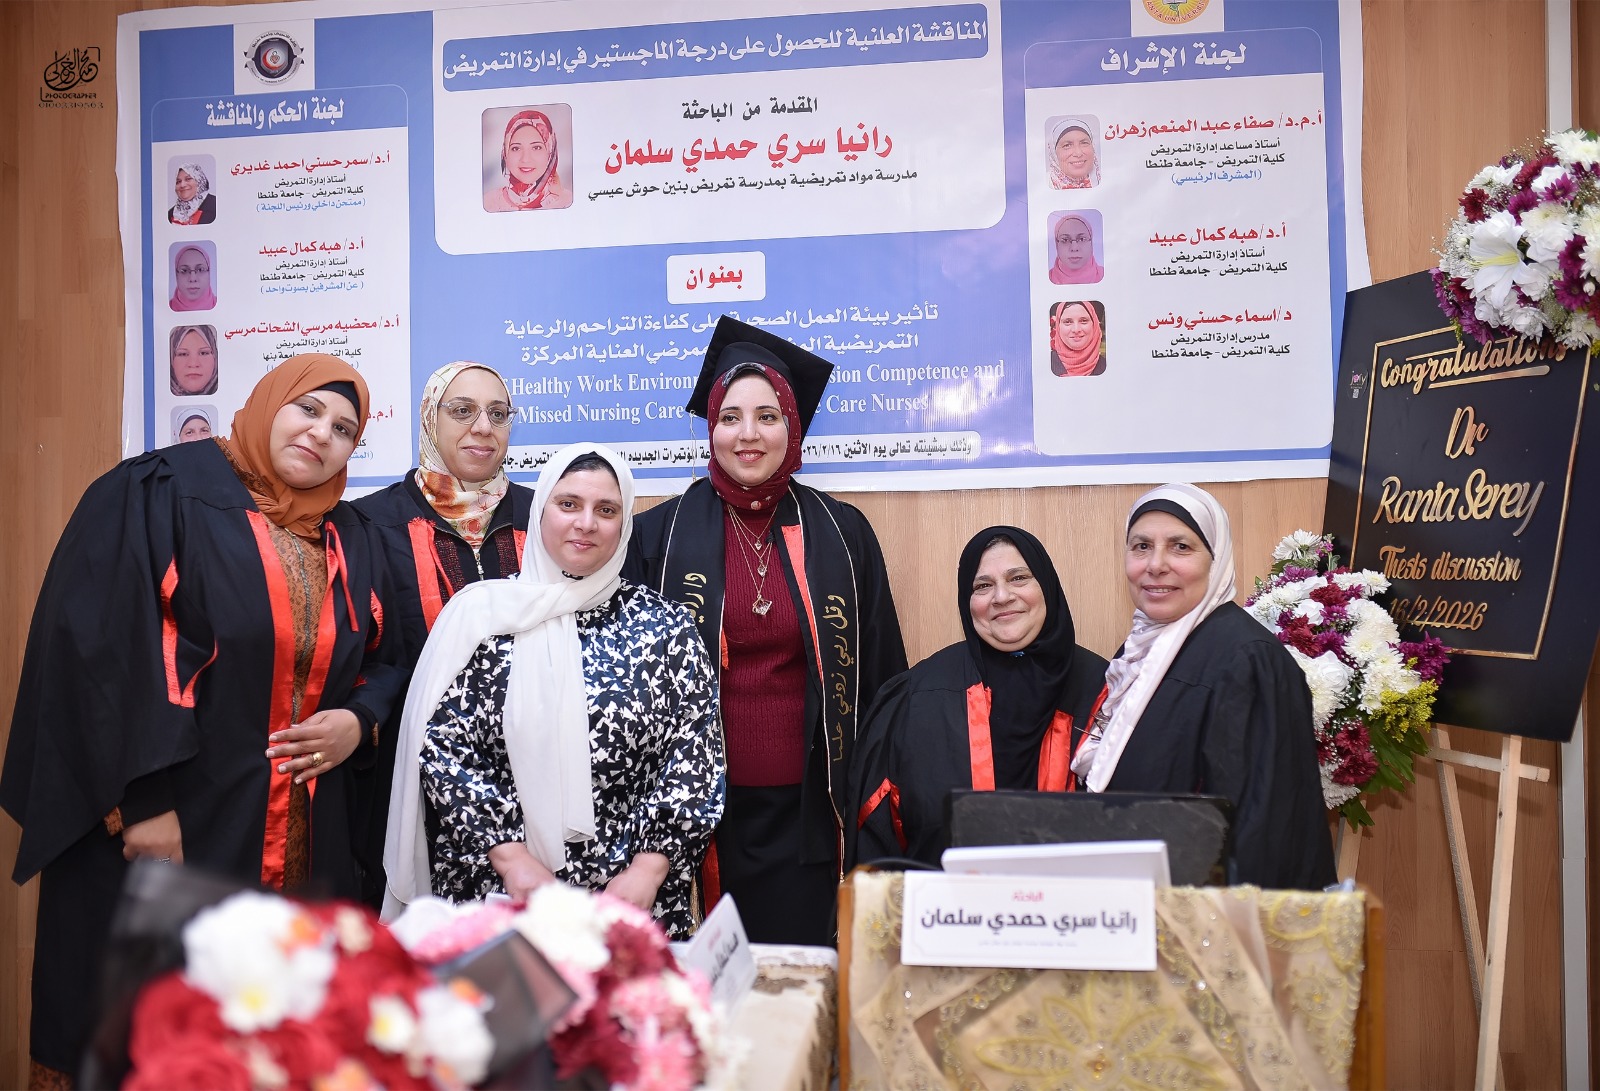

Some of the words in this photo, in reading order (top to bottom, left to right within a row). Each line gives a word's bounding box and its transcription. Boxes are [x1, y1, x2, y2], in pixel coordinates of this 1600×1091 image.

[846, 25, 910, 51] العلنية
[912, 20, 987, 42] المناقشة
[676, 38, 728, 62] درجة
[729, 36, 765, 61] على
[769, 30, 842, 57] للحصول
[523, 48, 561, 72] إدارة
[563, 46, 587, 74] في
[588, 40, 674, 67] الماجستير
[1100, 42, 1186, 76] الإشراف
[1193, 42, 1247, 71] لجنة
[444, 50, 521, 79] التمريض
[310, 97, 345, 126] لجنة
[682, 98, 733, 123] الباحثة
[742, 101, 761, 121] من
[771, 96, 818, 114] المقدمة
[206, 100, 264, 130] والمناقشة
[268, 100, 308, 130] الحكم
[1104, 121, 1147, 140] زهران
[1148, 118, 1198, 139] المنعم
[1200, 120, 1231, 134] عبد
[1234, 116, 1274, 131] صفاء
[836, 122, 893, 162] رانيا
[1150, 143, 1196, 156] التمريض
[1197, 142, 1218, 153] إدارة
[1220, 142, 1253, 150] مساعد
[1255, 137, 1281, 149] أستاذ
[604, 138, 674, 175] سلمان
[682, 135, 758, 174] حمدي
[767, 132, 826, 169] سري
[1263, 152, 1286, 164] كلية
[230, 160, 270, 176] غديري
[305, 157, 342, 172] حسني
[344, 157, 368, 168] سمر
[1145, 159, 1173, 169] طنطا
[1175, 157, 1206, 169] جامعة
[1217, 154, 1262, 168] التمريض
[326, 173, 346, 184] أستاذ
[739, 175, 786, 190] بمدرسة
[790, 172, 846, 187] تمريضية
[847, 172, 874, 184] مواد
[875, 168, 918, 182] مدرسة
[274, 178, 308, 189] التمريض
[348, 186, 364, 196] كلية
[627, 182, 660, 199] حوش
[662, 182, 689, 195] بنين
[690, 177, 736, 194] تمريض
[258, 191, 278, 199] طنطا
[280, 189, 304, 198] جامعة
[312, 188, 346, 198] التمريض
[1149, 231, 1188, 247] عبيد
[1190, 226, 1226, 246] كمال
[259, 246, 288, 258] عبيد
[290, 240, 318, 256] كمال
[319, 243, 342, 254] هبه
[1240, 246, 1266, 259] أستاذ
[328, 256, 348, 266] أستاذ
[1170, 250, 1216, 264] التمريض
[276, 260, 309, 271] التمريض
[348, 268, 364, 278] كلية
[1150, 266, 1177, 277] طنطا
[1178, 266, 1211, 277] جامعة
[1219, 263, 1264, 276] التمريض
[1266, 262, 1288, 274] كلية
[260, 274, 281, 282] طنطا
[282, 272, 306, 282] جامعة
[312, 270, 347, 281] التمريض
[686, 266, 743, 290] بعنوان
[799, 308, 847, 329] العمل
[850, 305, 890, 327] بيئة
[891, 300, 939, 326] تأثير
[1184, 311, 1234, 331] حسني
[257, 322, 300, 334] الشحات
[504, 318, 576, 340] والرعاية
[576, 315, 643, 338] التراحم
[643, 312, 690, 332] كفاءة
[224, 328, 256, 340] مرسي
[300, 324, 332, 337] مرسي
[1238, 333, 1270, 344] مدرس
[276, 338, 310, 350] التمريض
[328, 336, 348, 346] أستاذ
[823, 333, 920, 354] التمريضية
[1170, 333, 1216, 346] التمريض
[345, 348, 362, 358] كلية
[521, 345, 584, 366] المركزة
[585, 342, 645, 363] العناية
[1152, 349, 1180, 359] طنطا
[1180, 348, 1214, 360] جامعة
[1222, 346, 1267, 358] التمريض
[1268, 344, 1291, 357] كلية
[511, 376, 572, 399] Healthy
[577, 374, 624, 393] Work
[829, 365, 862, 384] sion
[866, 362, 969, 386] Competence
[973, 360, 1005, 379] and
[518, 402, 572, 424] Missed
[576, 402, 641, 425] Nursing
[644, 401, 686, 420] Care
[826, 394, 867, 414] Care
[870, 392, 929, 412] Nurses
[1445, 406, 1490, 460] Dr
[844, 439, 871, 459] الاثنين
[873, 445, 886, 458] يوم
[889, 440, 912, 457] تعالى
[1372, 475, 1460, 524] Rania
[1458, 468, 1545, 537] Serey
[1379, 545, 1428, 581] Thesis
[1430, 551, 1522, 582] discussion
[1390, 594, 1488, 632] 16/2/2026
[921, 908, 983, 930] سلمان
[987, 914, 1047, 936] حمدي
[1053, 913, 1097, 937] سري
[1101, 909, 1138, 934] رانيا
